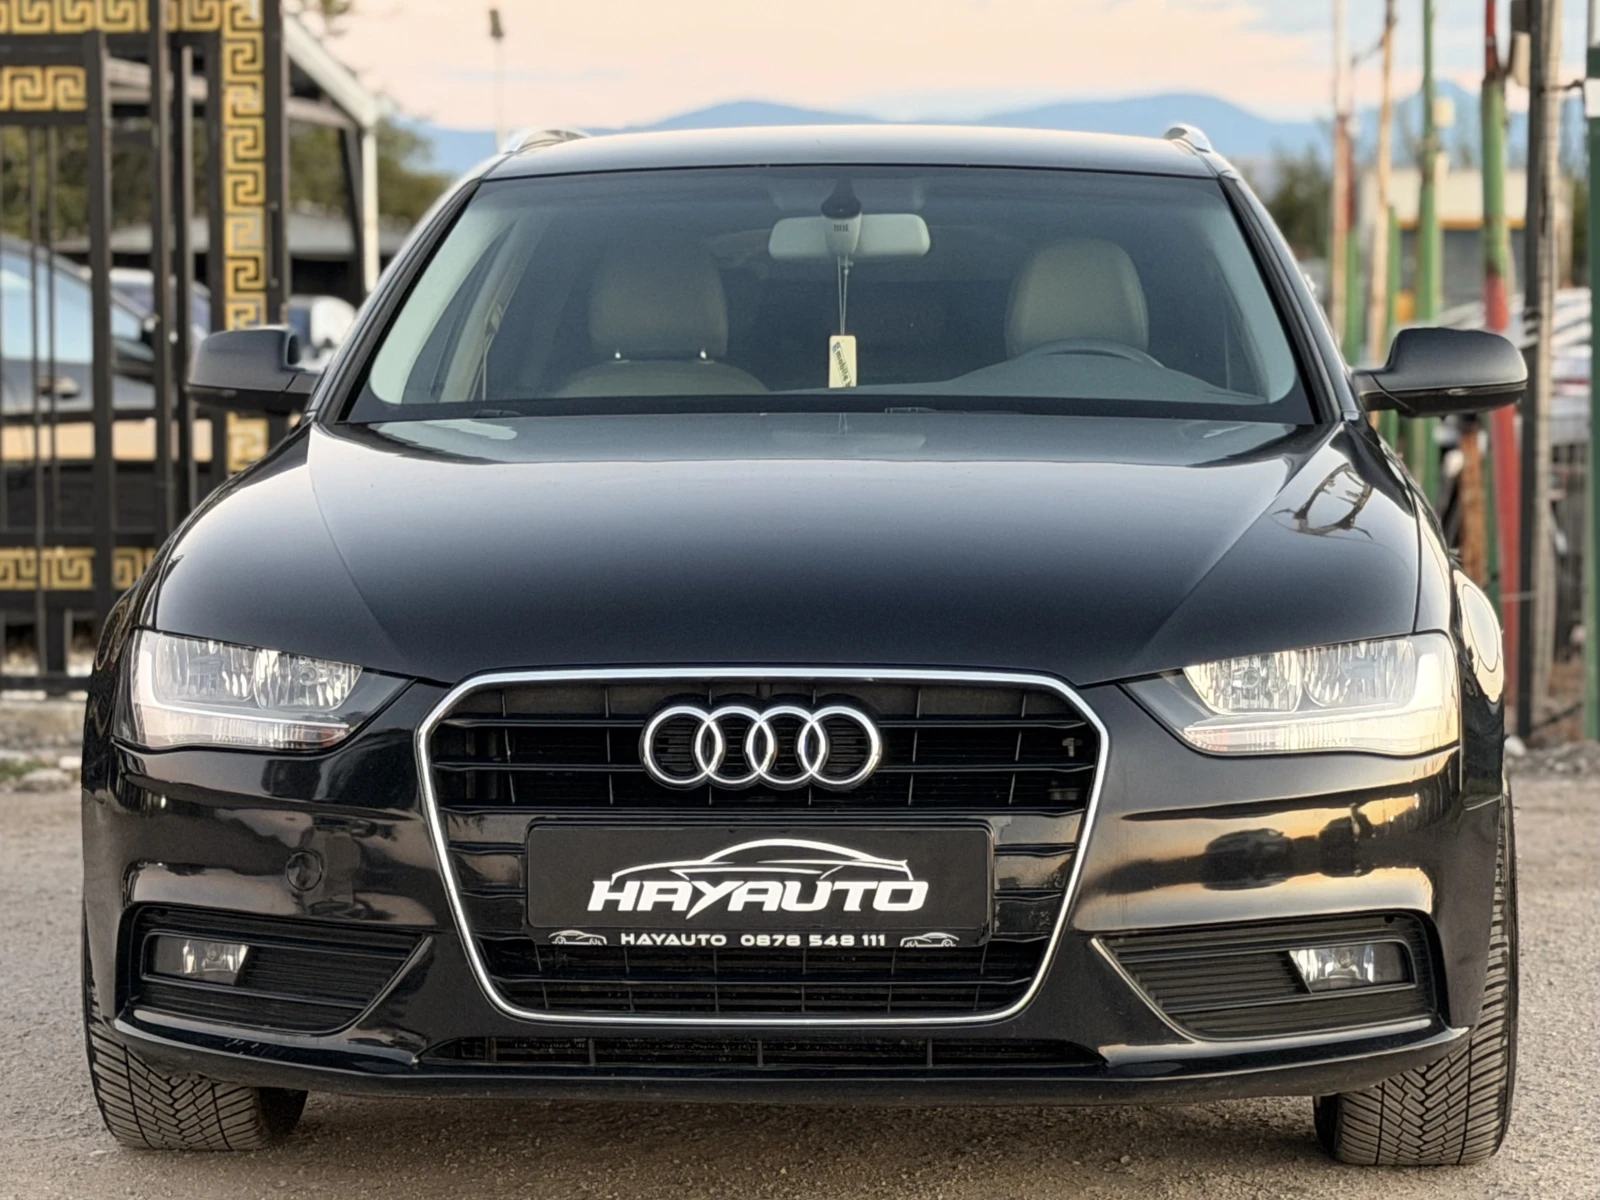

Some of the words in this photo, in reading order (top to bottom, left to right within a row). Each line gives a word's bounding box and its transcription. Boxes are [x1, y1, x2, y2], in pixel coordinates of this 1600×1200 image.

[586, 880, 929, 919] HAYAUTO
[620, 932, 727, 947] HAYAUTO
[740, 933, 801, 947] 0878
[808, 933, 855, 947] 548
[861, 933, 886, 947] 111
